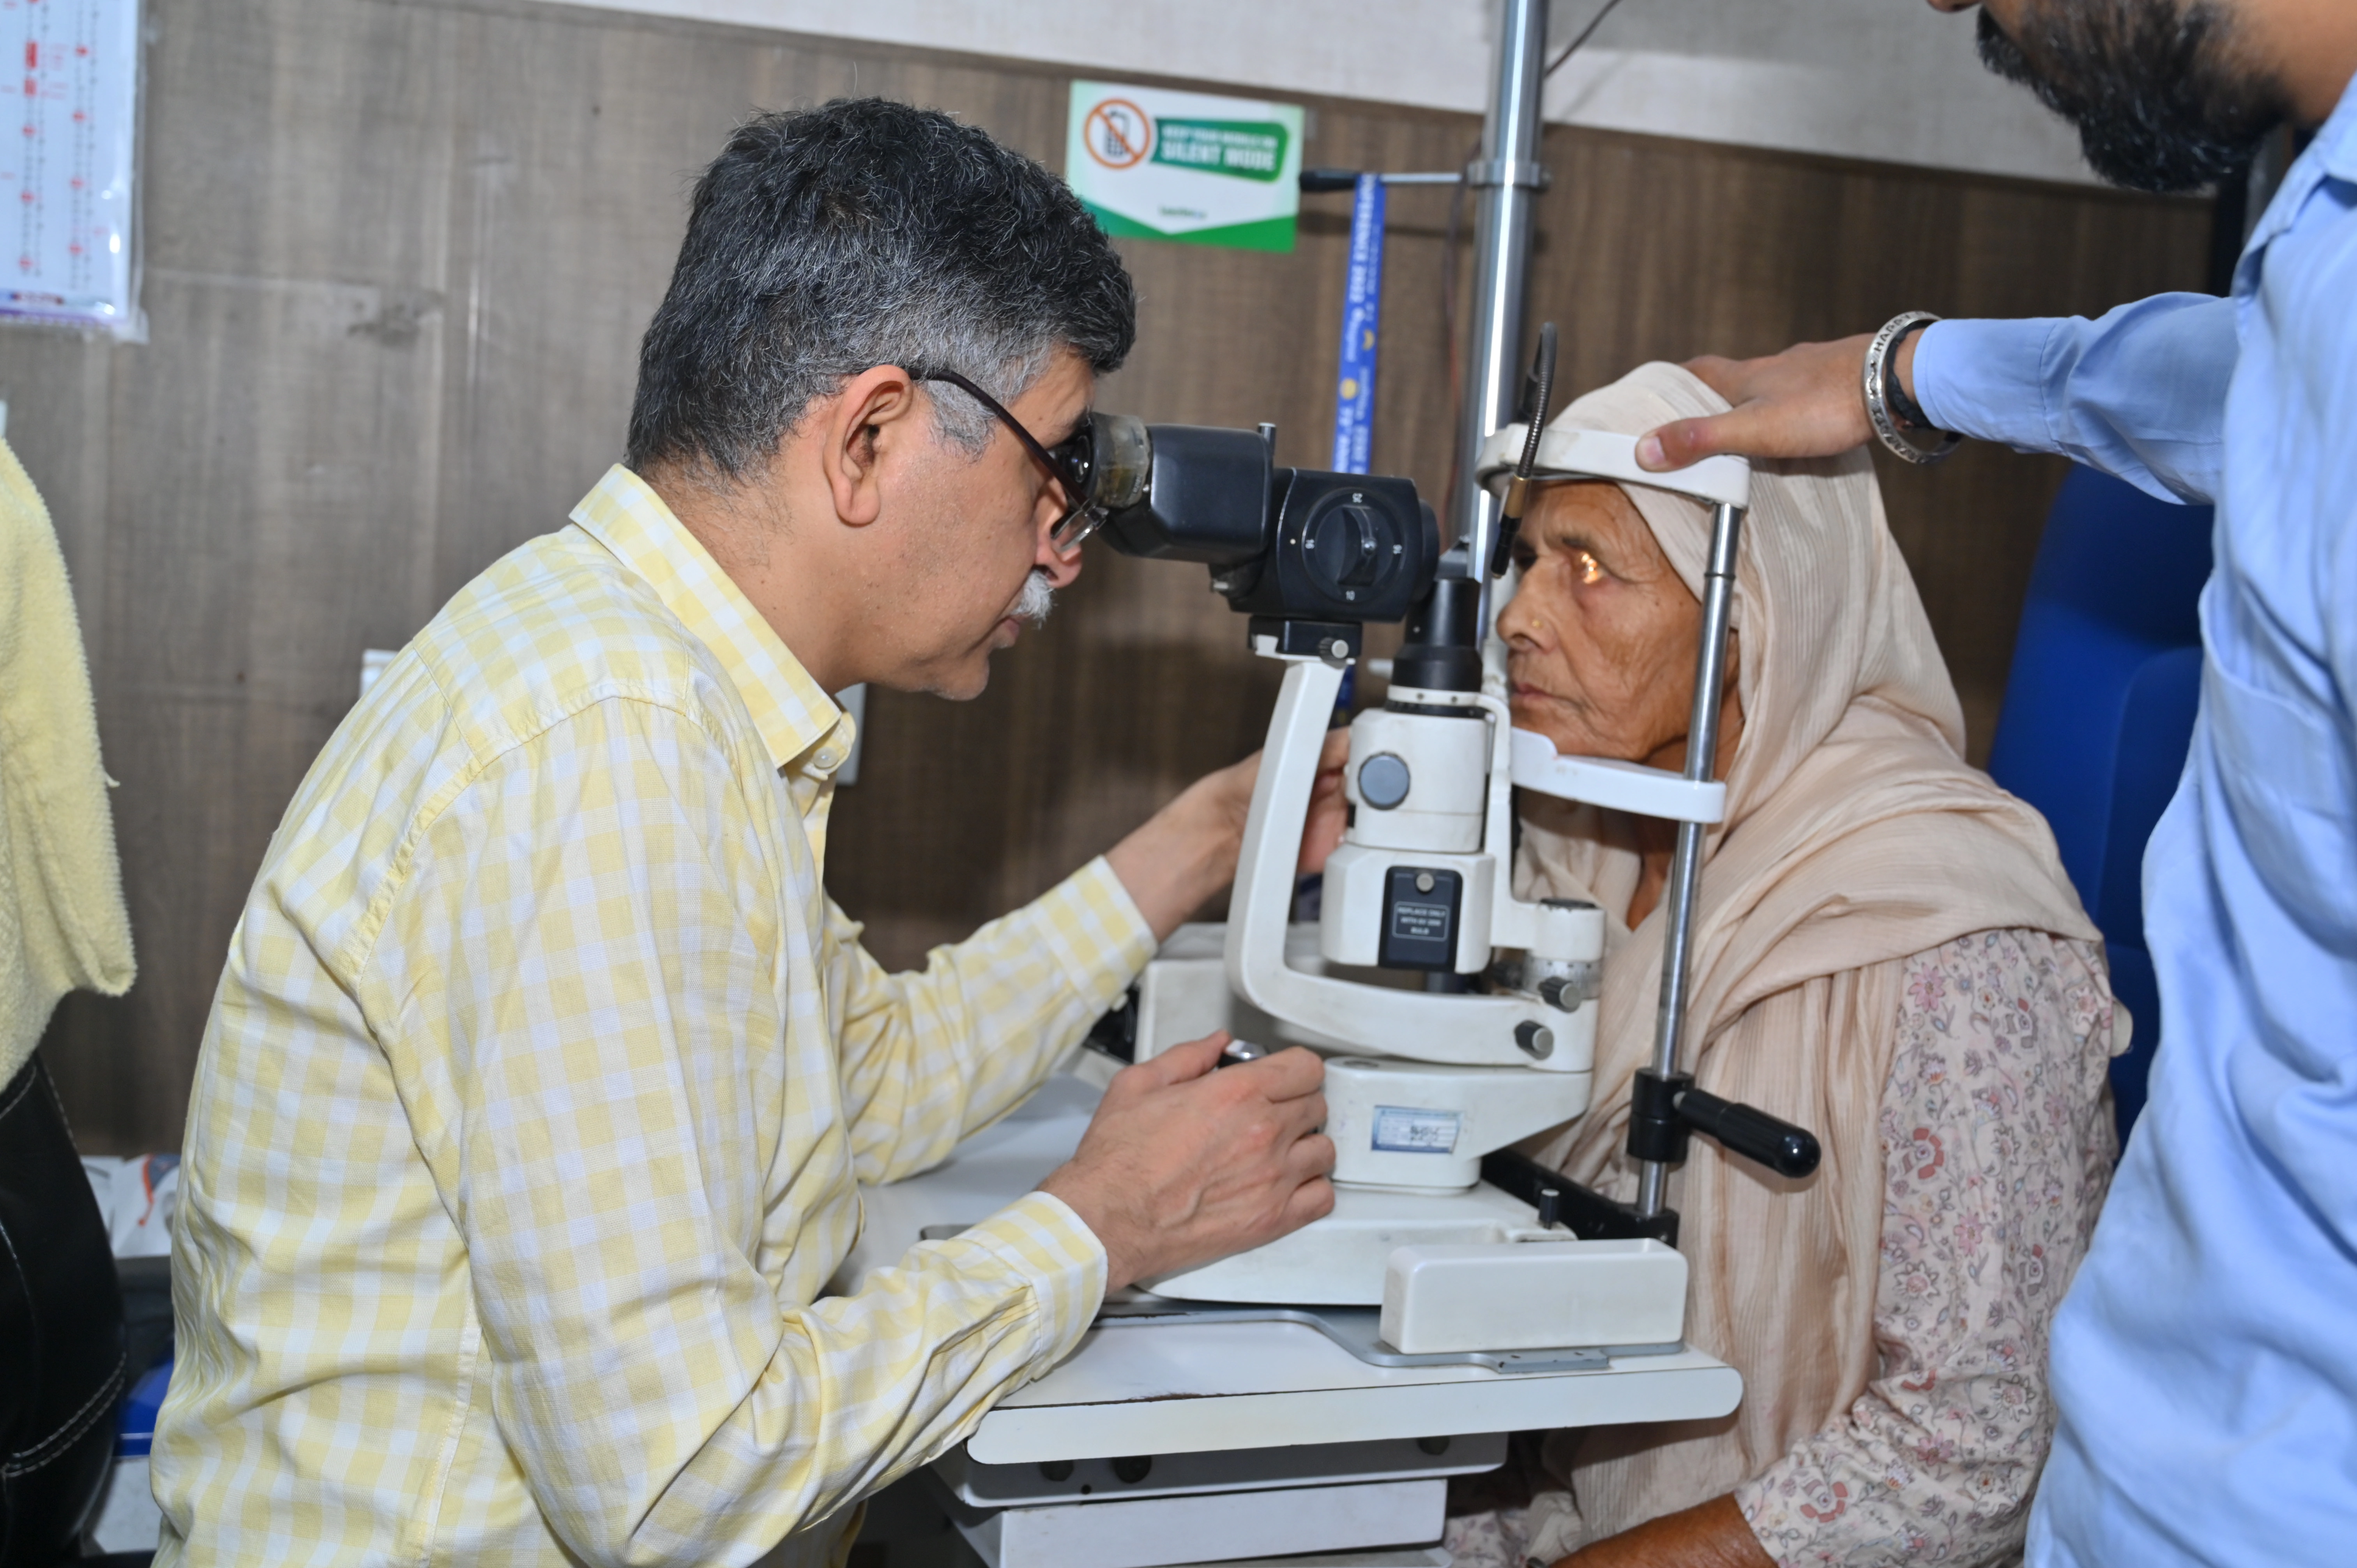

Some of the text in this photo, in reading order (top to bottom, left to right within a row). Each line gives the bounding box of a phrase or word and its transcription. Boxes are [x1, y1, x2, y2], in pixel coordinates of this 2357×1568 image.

[1163, 141, 1275, 171] SILENT MODE
[1874, 314, 1911, 351] HAPPY
[1352, 493, 1363, 503] 25
[1305, 539, 1315, 549] 16
[1346, 590, 1355, 601] 10
[1397, 906, 1446, 917] REPLACE ONLY
[1410, 926, 1430, 935] BULB
